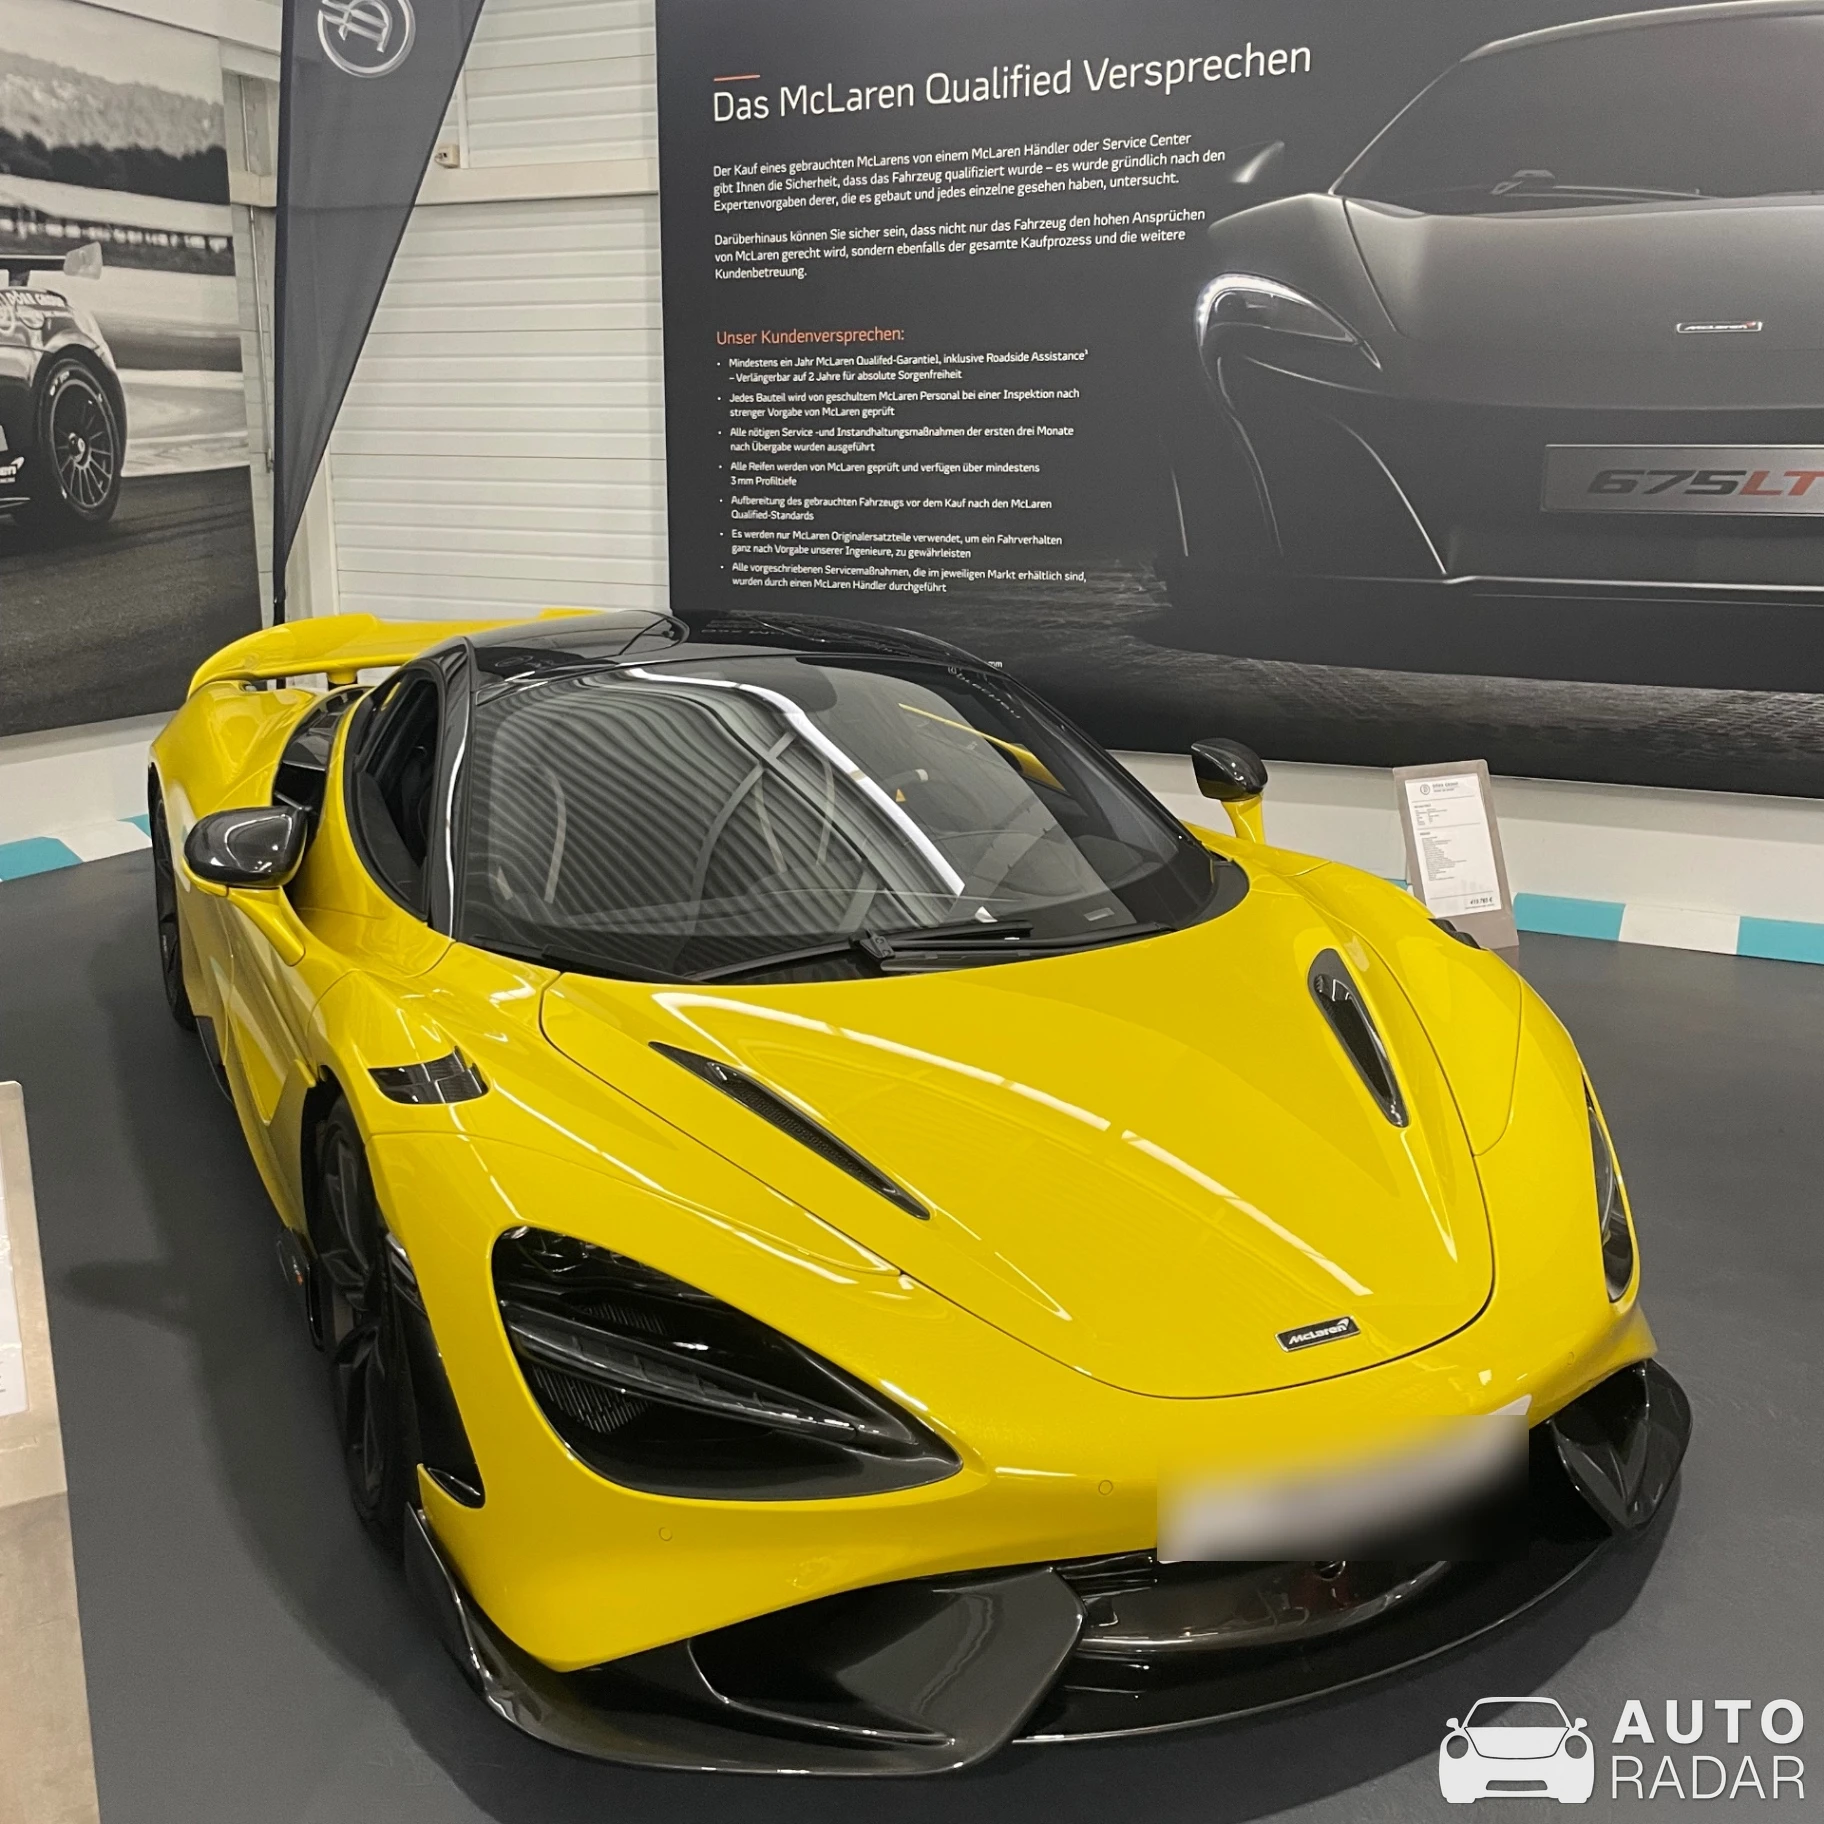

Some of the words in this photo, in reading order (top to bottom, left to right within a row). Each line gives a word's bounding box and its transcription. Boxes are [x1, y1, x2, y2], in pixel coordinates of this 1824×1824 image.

[714, 91, 769, 121] Das
[780, 82, 913, 116] McLaren
[926, 59, 1071, 104] Qualified
[1083, 42, 1311, 95] Versprechen
[713, 165, 731, 177] Der
[734, 162, 757, 175] Kauf
[760, 162, 786, 174] eines
[789, 157, 854, 175] gebrauchten
[857, 155, 910, 167] McLarens
[912, 153, 932, 163] von
[935, 149, 968, 162] einem
[971, 147, 1020, 159] McLaren
[1023, 141, 1070, 156] Händler
[1072, 139, 1099, 152] oder
[1102, 136, 1147, 150] Service
[1149, 133, 1191, 146] Center
[713, 182, 733, 197] gibt
[736, 181, 765, 193] Ihnen
[767, 179, 782, 191] die
[785, 175, 840, 190] Sicherheit,
[842, 174, 867, 186] dass
[870, 172, 889, 184] das
[892, 170, 942, 184] Fahrzeug
[944, 165, 1005, 183] qualifiziert
[1007, 161, 1043, 176] wurde
[1055, 162, 1069, 172] es
[1071, 156, 1108, 171] wurde
[1110, 152, 1167, 172] gründlich
[1170, 150, 1199, 164] nach
[1202, 149, 1225, 162] den
[714, 195, 806, 213] Expertenvorgaben
[808, 194, 838, 206] derer,
[841, 192, 856, 204] die
[859, 193, 871, 203] es
[873, 189, 911, 205] gebaut
[914, 186, 934, 200] und
[936, 185, 966, 202] jedes
[968, 182, 1015, 197] einzelne
[1017, 179, 1065, 197] gesehen
[1068, 176, 1106, 190] haben,
[1109, 171, 1179, 187] untersucht.
[714, 232, 788, 245] Darüberhinaus
[790, 230, 827, 242] können
[829, 228, 846, 240] Sie
[848, 226, 880, 239] sicher
[883, 225, 907, 238] sein,
[910, 224, 936, 236] dass
[938, 221, 966, 234] nicht
[969, 223, 988, 232] nur
[990, 219, 1011, 232] das
[1013, 217, 1066, 231] Fahrzeug
[1069, 215, 1090, 227] den
[1093, 213, 1129, 226] hohen
[1131, 208, 1205, 226] Ansprüchen
[714, 253, 733, 262] von
[735, 250, 779, 261] McLaren
[781, 246, 821, 263] gerecht
[823, 245, 848, 258] wird,
[851, 243, 894, 256] sondern
[896, 240, 945, 254] ebenfalls
[948, 239, 966, 252] der
[968, 238, 1018, 254] gesamte
[1020, 234, 1092, 250] Kaufprozess
[1094, 231, 1116, 244] und
[1119, 230, 1137, 243] die
[1140, 229, 1185, 242] weitere
[715, 266, 807, 279] Kundenbetreuung.
[716, 331, 757, 345] Unser
[761, 325, 904, 346] Kundenversprechen:
[728, 357, 778, 367] Mindestens
[779, 357, 792, 367] ein
[794, 356, 814, 366] Jahr
[815, 356, 854, 366] McLaren
[943, 353, 984, 363] inklusive
[986, 351, 1029, 362] Roadside
[735, 372, 791, 384] Verlängerbar
[792, 371, 807, 381] auf
[808, 371, 814, 381] 2
[815, 371, 840, 381] Jahre
[842, 370, 855, 380] für
[857, 370, 896, 380] absolute
[897, 368, 962, 382] Sorgenfreiheit
[729, 393, 754, 402] Jedes
[755, 392, 786, 402] Bauteil
[787, 392, 806, 401] wird
[808, 393, 824, 401] von
[825, 391, 877, 404] geschultem
[878, 391, 918, 401] McLaren
[919, 389, 960, 400] Personal
[961, 389, 975, 399] bei
[977, 389, 1001, 399] einer
[1003, 388, 1054, 401] Inspektion
[1056, 387, 1079, 398] nach
[729, 408, 765, 419] strenger
[767, 407, 802, 419] Vorgabe
[804, 408, 820, 416] von
[821, 406, 860, 416] McLaren
[861, 405, 895, 419] geprüft
[730, 427, 746, 436] Alle
[748, 427, 780, 439] nötigen
[781, 427, 813, 437] Service
[966, 425, 982, 436] der
[984, 427, 1015, 436] ersten
[1016, 425, 1034, 436] drei
[1036, 425, 1074, 435] Monate
[730, 441, 750, 451] nach
[751, 440, 792, 454] Übergabe
[793, 441, 825, 451] wurden
[826, 441, 875, 454] ausgeführt
[730, 461, 747, 471] Alle
[748, 461, 775, 471] Reifen
[776, 462, 807, 471] werden
[809, 463, 825, 471] von
[827, 462, 865, 472] McLaren
[866, 462, 900, 474] geprüft
[901, 462, 918, 472] und
[920, 462, 961, 475] verfügen
[962, 462, 983, 472] über
[985, 462, 1040, 472] mindestens
[1587, 470, 1824, 496] 675LT
[730, 495, 785, 508] Aufbereitung
[786, 496, 802, 505] des
[803, 496, 857, 508] gebrauchten
[859, 497, 904, 510] Fahrzeugs
[905, 499, 921, 507] vor
[922, 497, 942, 507] dem
[944, 497, 966, 508] Kauf
[967, 498, 989, 508] nach
[991, 498, 1008, 508] den
[1010, 498, 1052, 508] McLaren
[731, 509, 814, 520] Qualified-Standards
[731, 528, 742, 538] Es
[743, 529, 774, 539] werden
[792, 530, 829, 540] McLaren
[831, 530, 911, 543] Originalersatzteile
[912, 533, 963, 544] verwendet,
[964, 535, 979, 543] um
[981, 533, 995, 544] ein
[997, 534, 1062, 545] Fahrverhalten
[731, 544, 751, 554] ganz
[753, 544, 773, 553] nach
[774, 544, 809, 556] Vorgabe
[810, 547, 843, 555] unserer
[845, 545, 893, 558] Ingenieure,
[895, 548, 906, 556] zu
[907, 547, 971, 559] gewährleisten
[1288, 1321, 1348, 1345] McLaren
